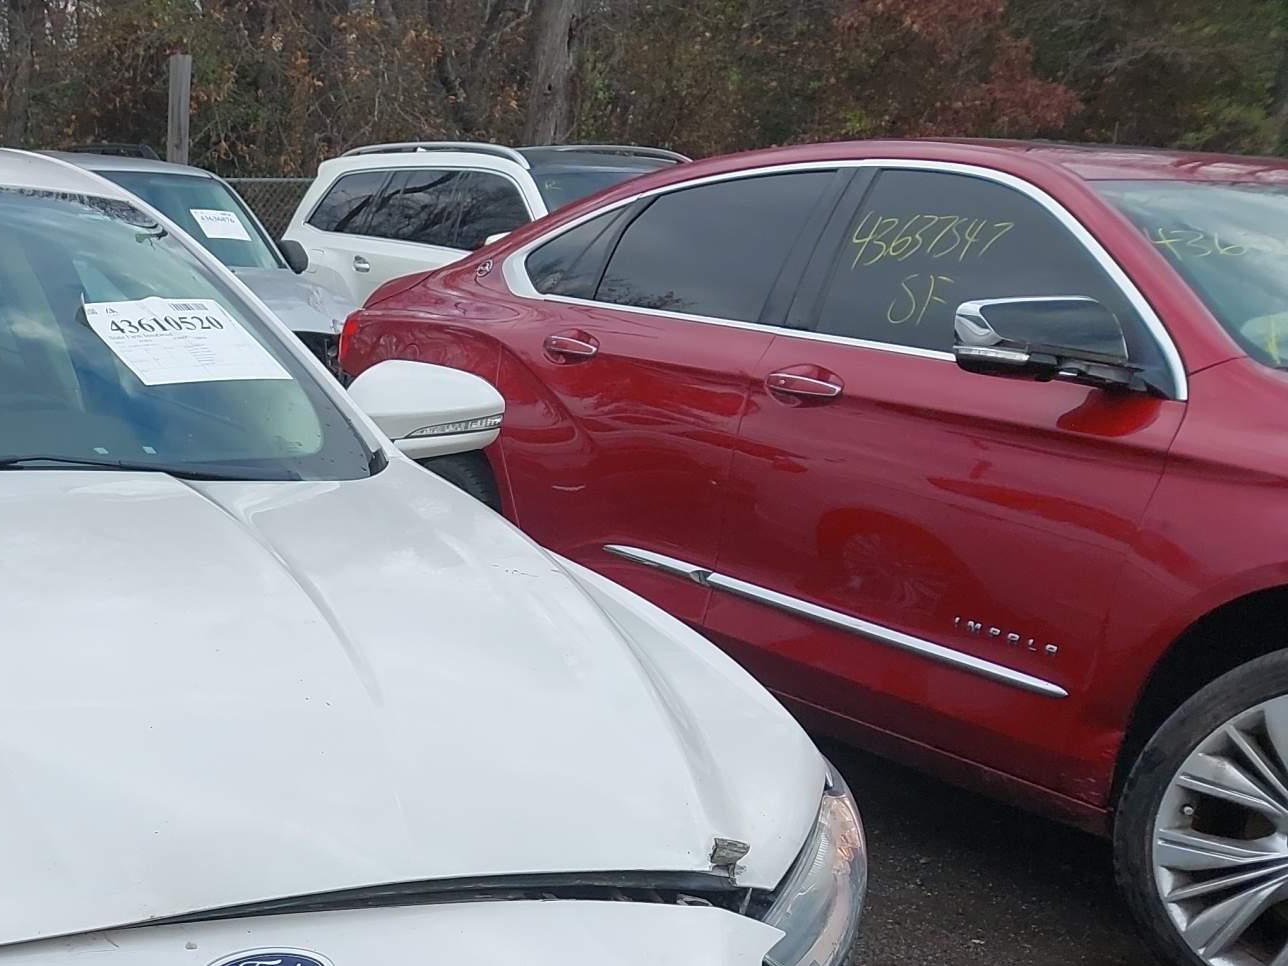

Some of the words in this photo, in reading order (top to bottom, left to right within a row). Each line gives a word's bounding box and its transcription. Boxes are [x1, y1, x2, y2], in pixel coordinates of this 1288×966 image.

[851, 210, 1014, 271] 43637547
[109, 315, 224, 334] 43610520
[887, 274, 954, 326] SF
